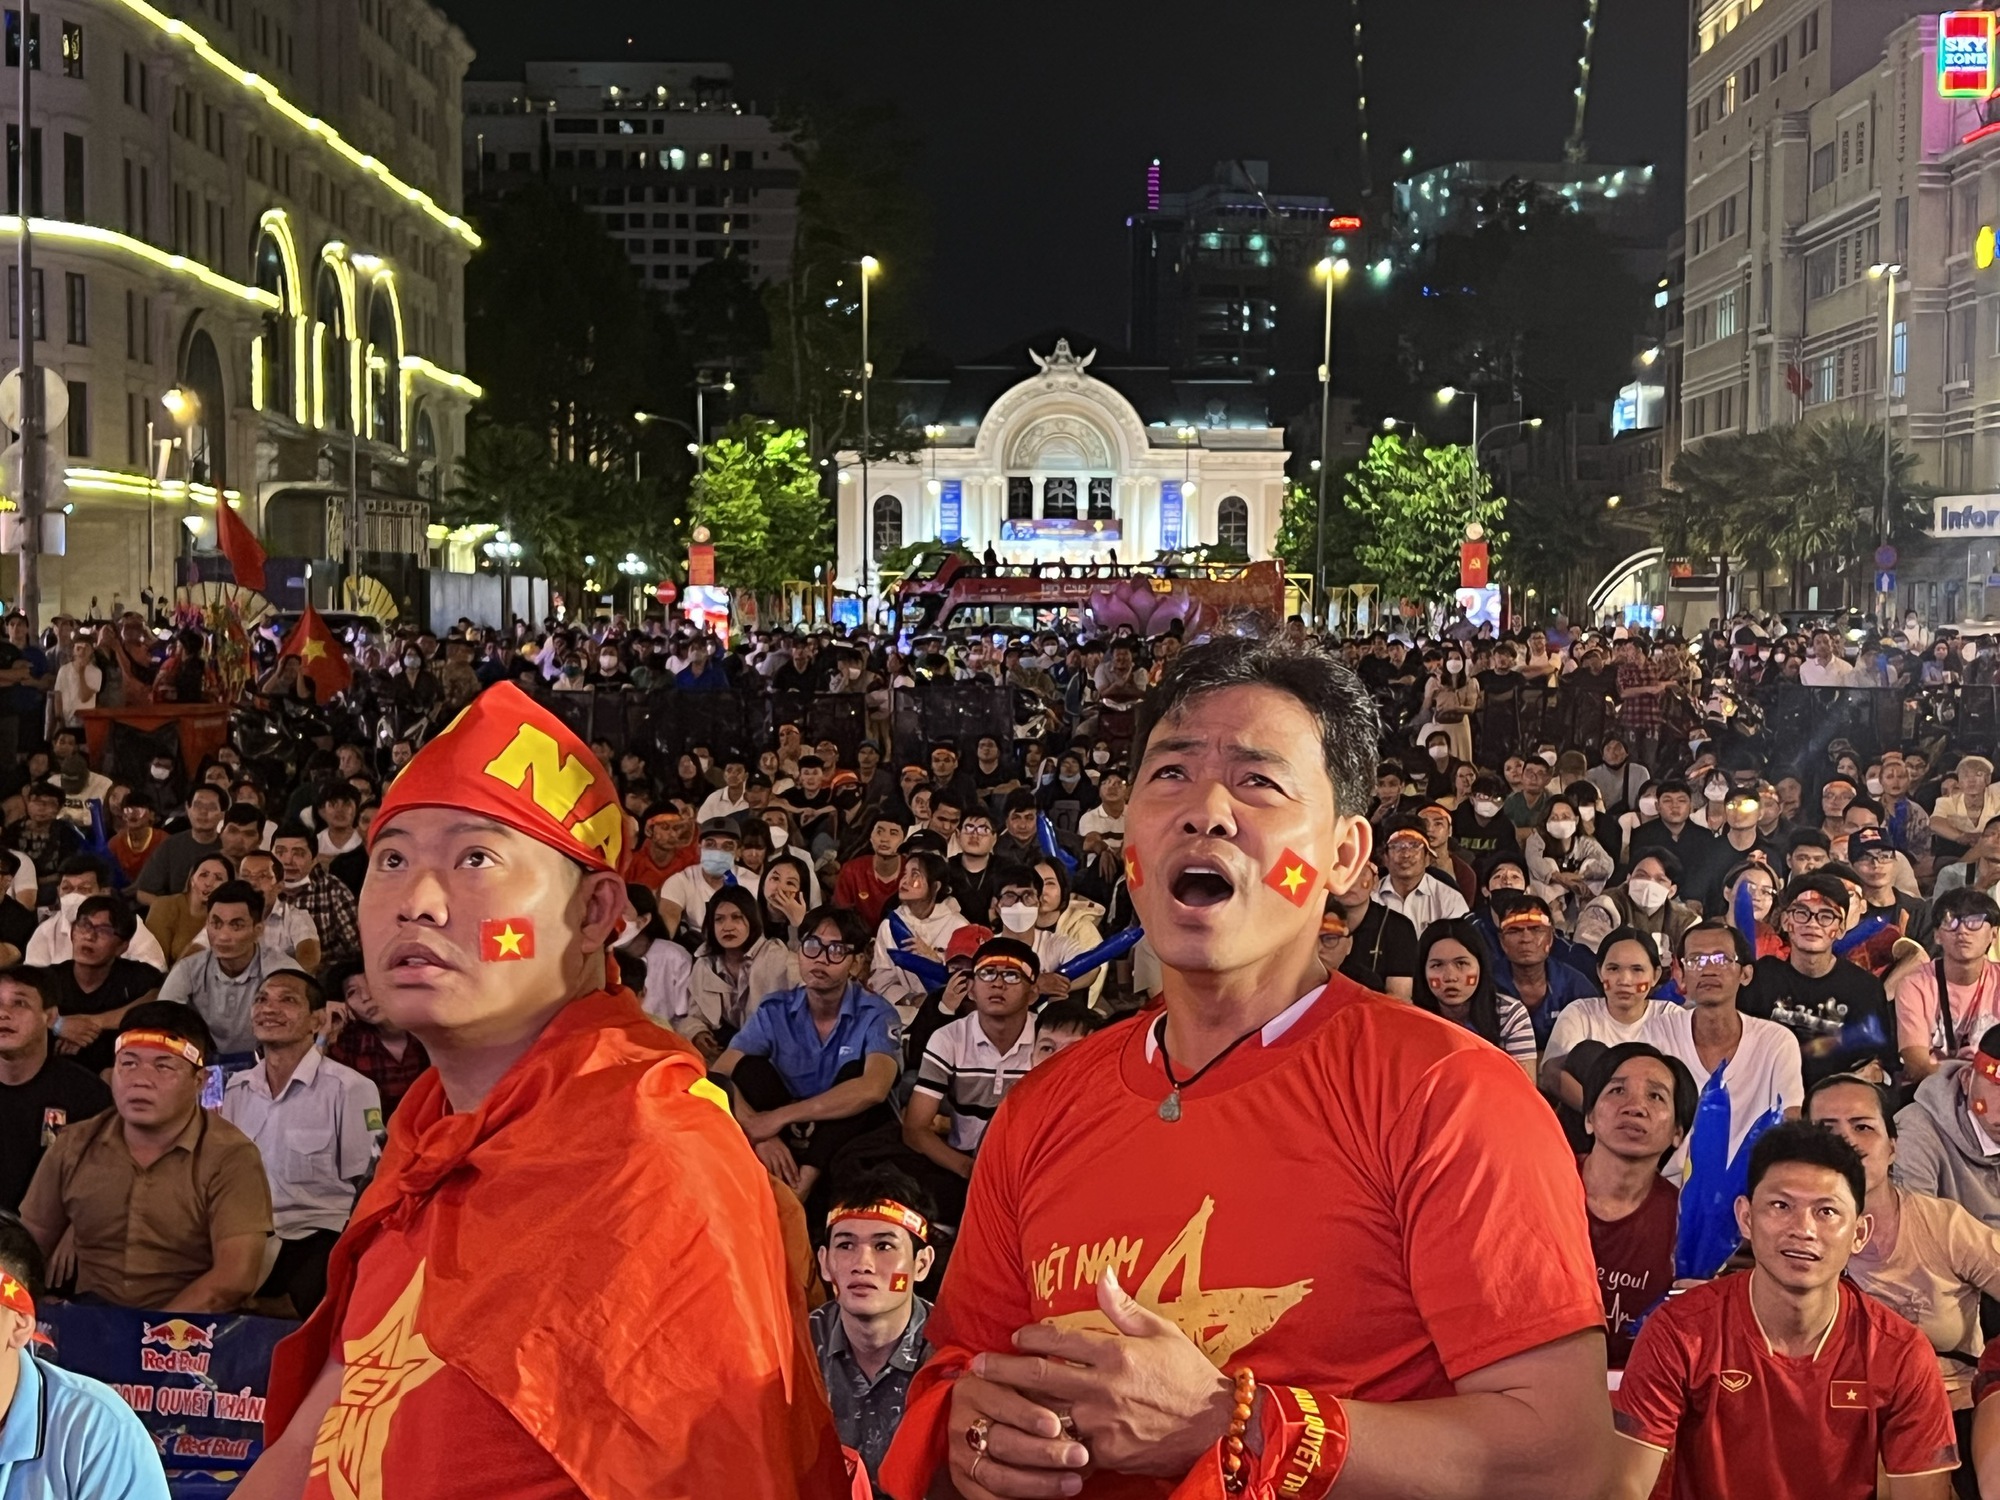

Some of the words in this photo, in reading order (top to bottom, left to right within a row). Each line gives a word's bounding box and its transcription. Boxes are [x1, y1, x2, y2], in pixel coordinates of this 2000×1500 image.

[1944, 38, 1987, 52] SKY
[1944, 53, 1987, 65] ZONE
[1074, 1235, 1144, 1291] NAM
[142, 1348, 176, 1372] Red
[177, 1351, 211, 1374] Bull
[113, 1384, 154, 1412] AM
[213, 1386, 266, 1423] THẮN
[173, 1433, 211, 1457] Red
[210, 1437, 250, 1460] Bull
